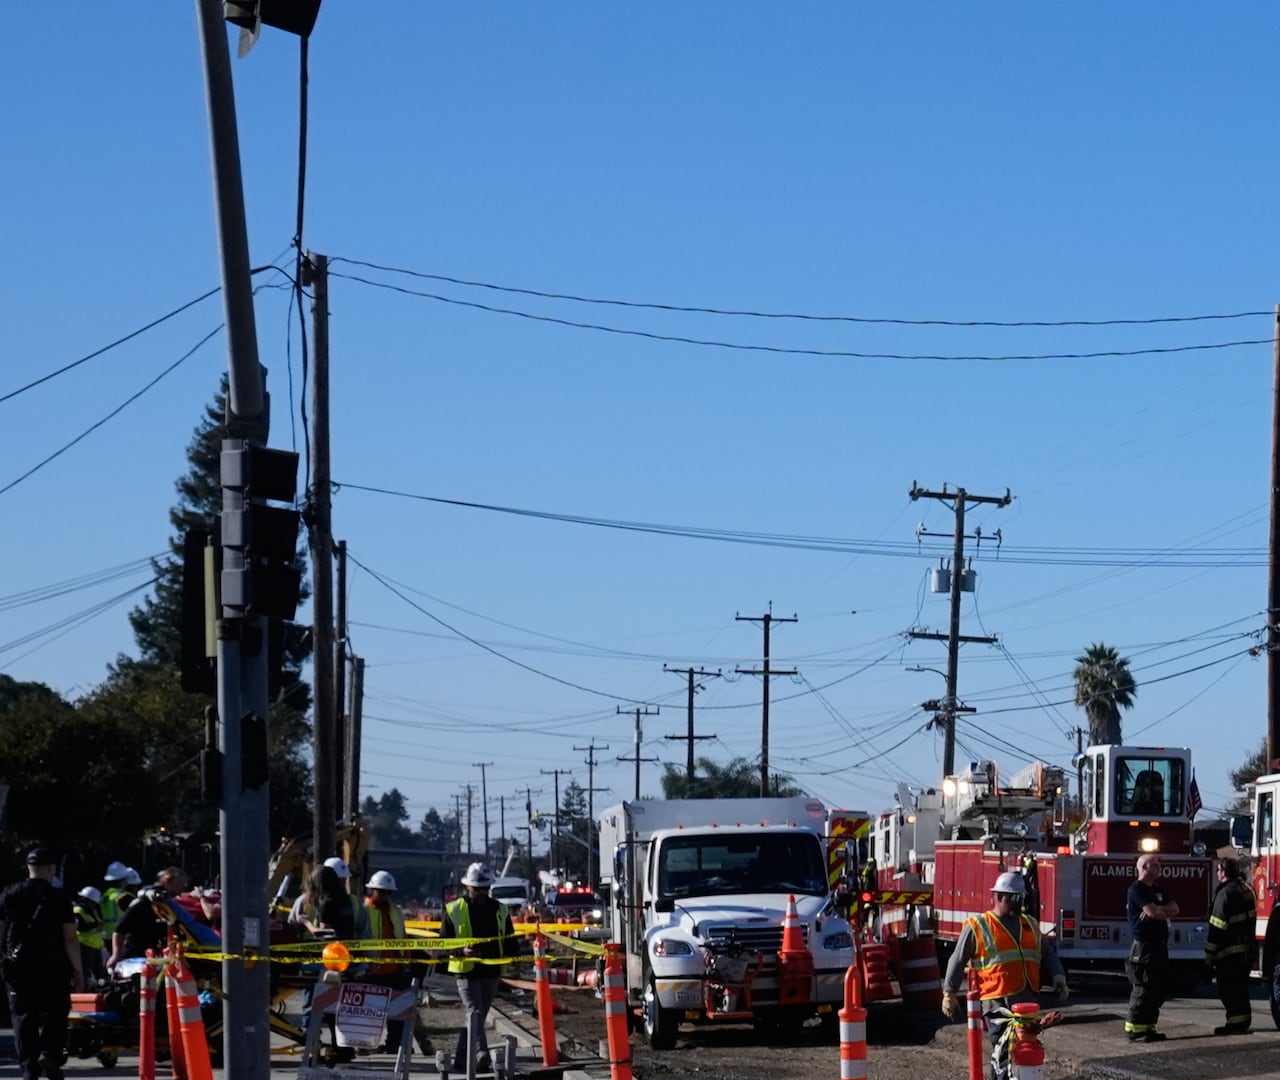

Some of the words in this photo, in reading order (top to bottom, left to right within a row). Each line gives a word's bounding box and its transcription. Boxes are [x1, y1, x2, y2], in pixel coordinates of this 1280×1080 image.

[1091, 865, 1138, 877] ALAME
[343, 992, 363, 1005] NO
[340, 1006, 383, 1018] PARKING
